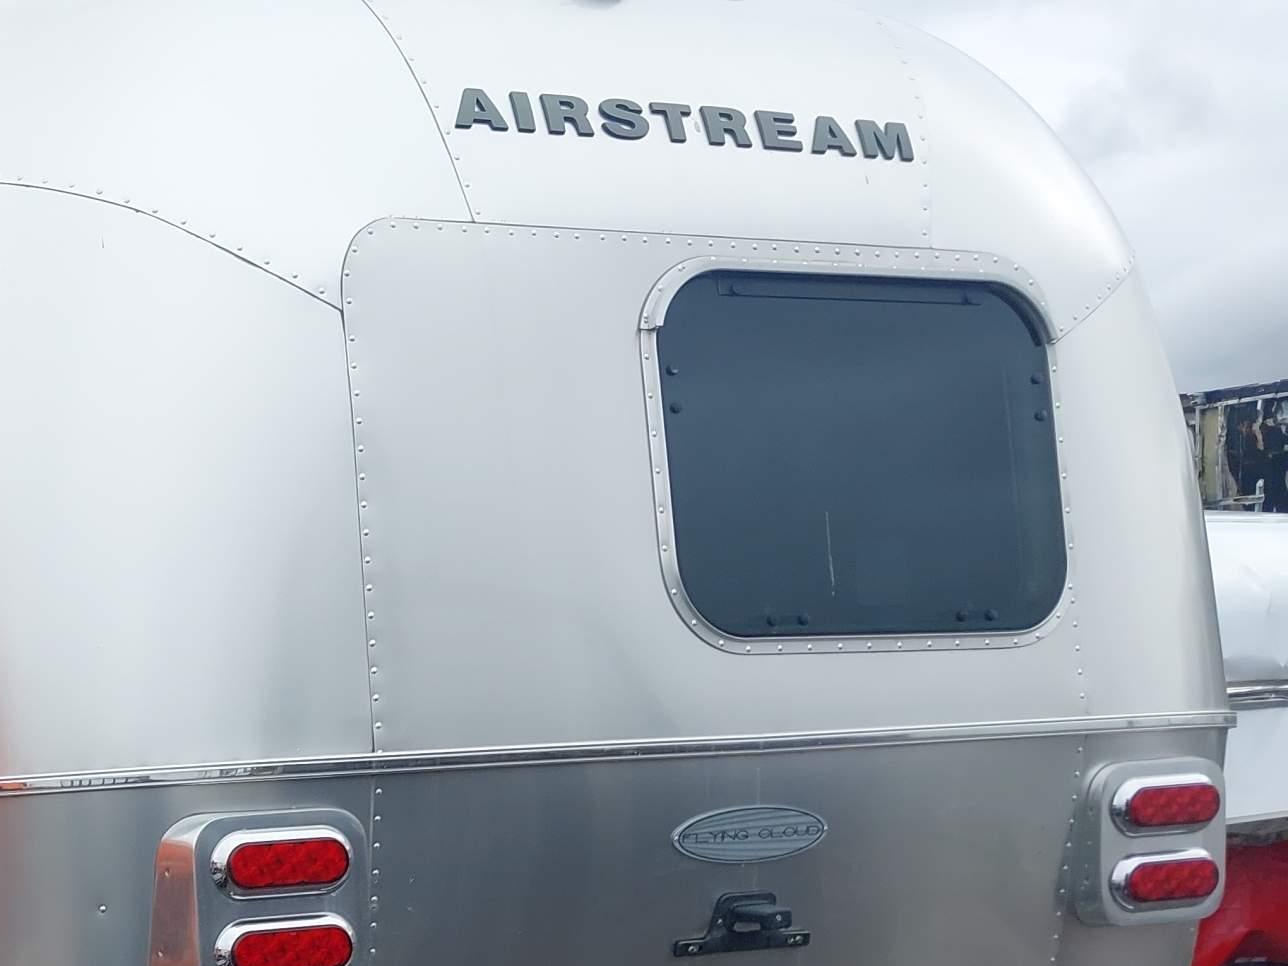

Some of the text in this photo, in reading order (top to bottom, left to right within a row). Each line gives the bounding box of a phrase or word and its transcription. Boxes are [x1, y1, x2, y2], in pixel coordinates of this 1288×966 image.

[454, 87, 915, 163] AIRSTREAM
[681, 825, 821, 844] FLYING CLOUD
